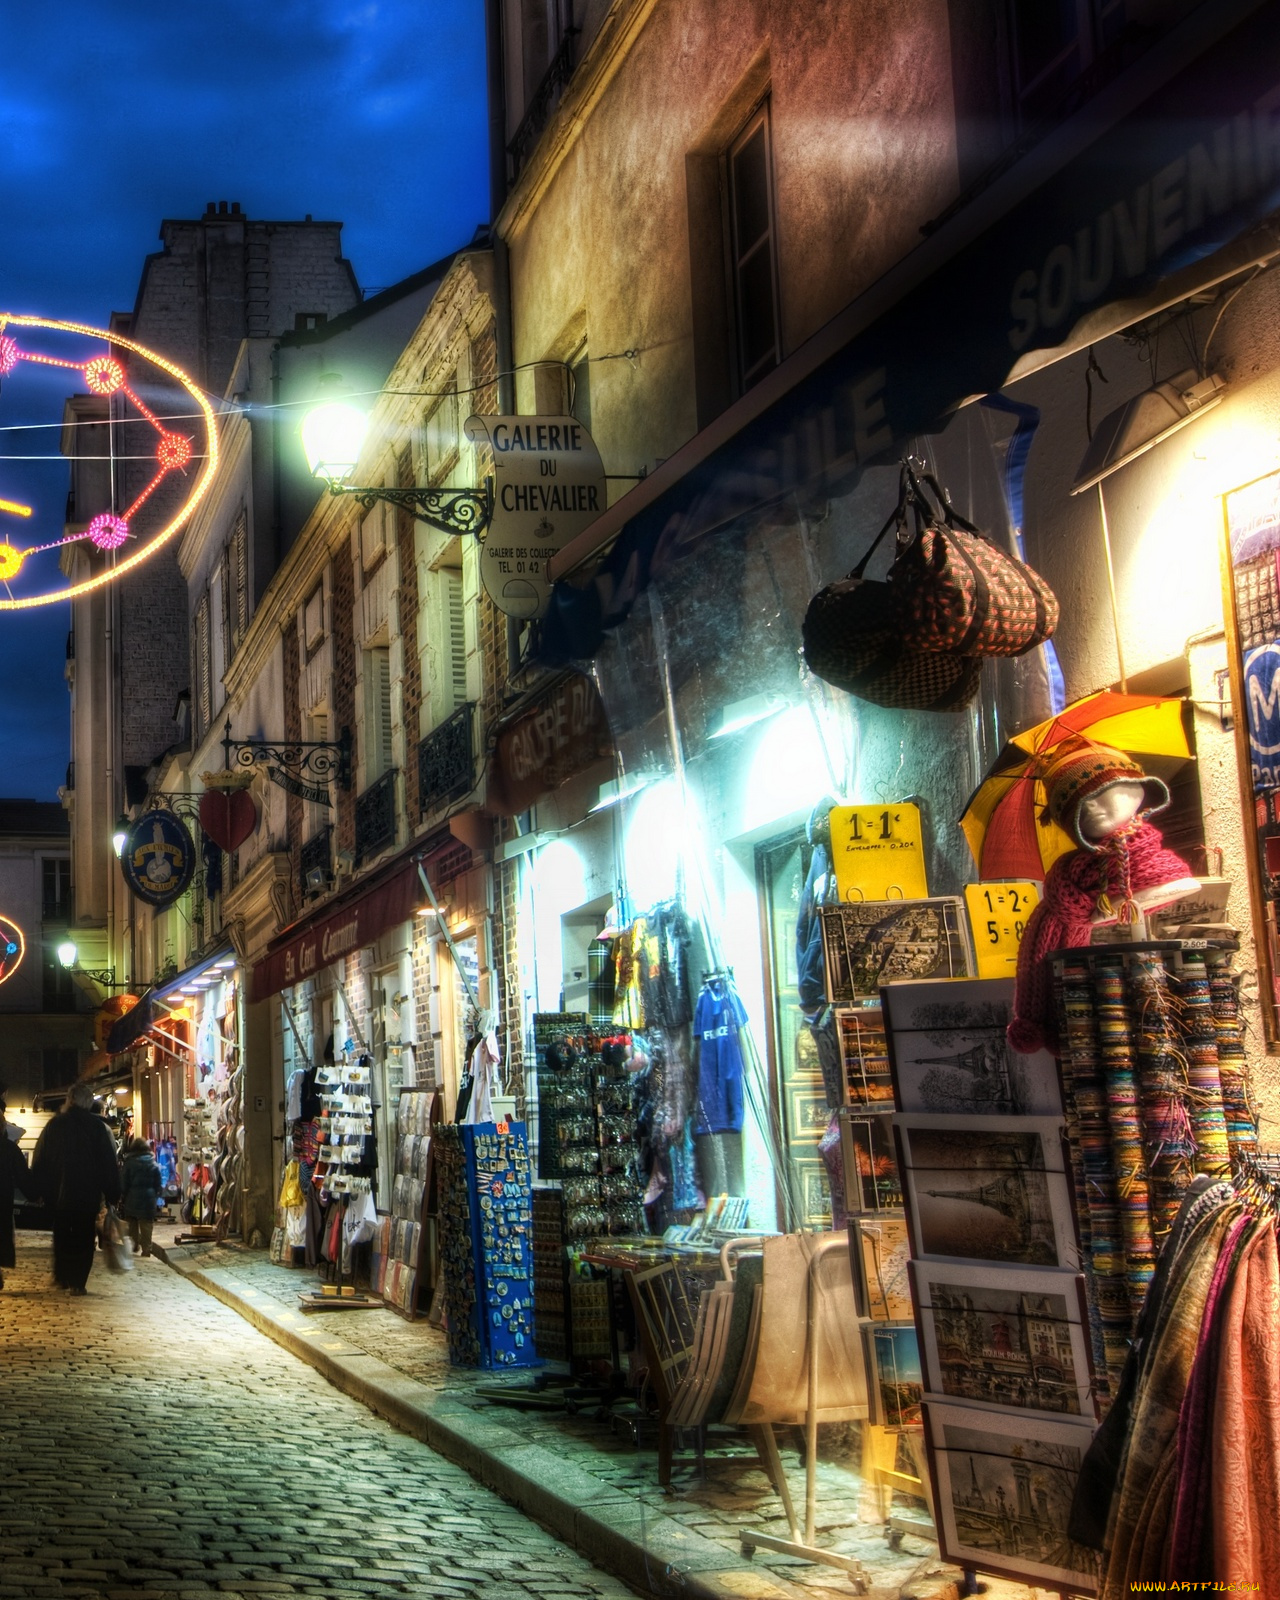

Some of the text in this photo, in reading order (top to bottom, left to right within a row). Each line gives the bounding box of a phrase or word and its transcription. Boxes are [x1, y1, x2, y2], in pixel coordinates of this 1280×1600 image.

[493, 424, 582, 452] GALERIE
[540, 459, 557, 477] DU
[501, 484, 600, 512] CHEVALIER
[516, 548, 528, 559] DES
[498, 561, 539, 573] TEL. 01 42
